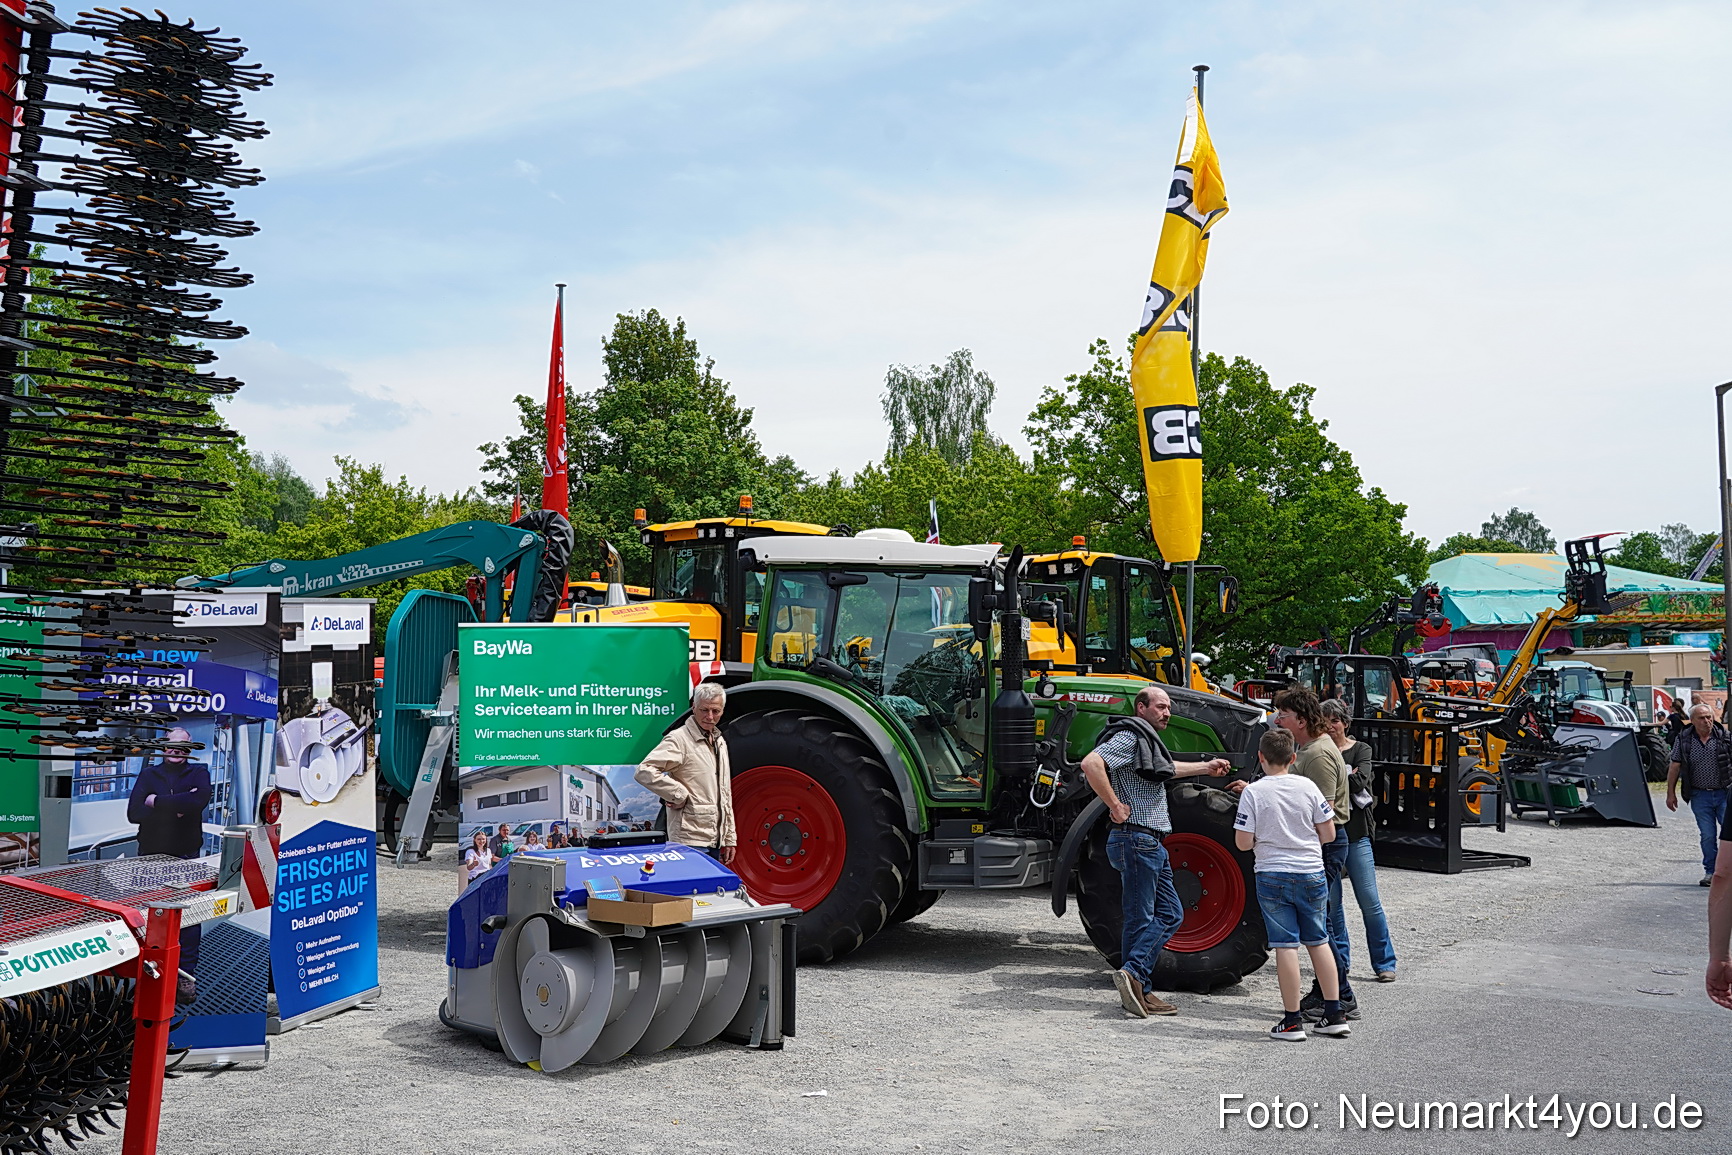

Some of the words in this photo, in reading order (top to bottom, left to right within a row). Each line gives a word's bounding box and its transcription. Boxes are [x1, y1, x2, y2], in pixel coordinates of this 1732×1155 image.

[676, 549, 693, 558] JCB
[341, 563, 369, 581] 4272
[201, 603, 257, 616] DeLaval
[323, 617, 364, 631] DeLaval
[105, 649, 146, 661] he
[153, 649, 200, 663] new
[474, 640, 533, 658] BayWa
[255, 690, 279, 706] DeLaval
[475, 685, 497, 698] Ihr
[500, 684, 544, 698] Melk-
[548, 684, 577, 697] und
[580, 683, 669, 699] Fütterungs-
[1068, 692, 1113, 703] FENDT
[166, 693, 226, 713] V300
[474, 702, 573, 717] Serviceteam
[575, 702, 588, 715] in
[592, 703, 628, 716] Ihrer
[631, 703, 675, 716] Nähe!
[1435, 710, 1454, 719] JCB
[474, 728, 495, 739] Wir
[497, 728, 543, 739] machen
[544, 730, 565, 739] uns
[566, 728, 594, 738] stark
[595, 728, 612, 738] für
[613, 728, 633, 738] Sie.
[278, 848, 307, 859] Schieben
[306, 845, 316, 854] Sie
[317, 844, 326, 852] Ihr
[327, 841, 342, 850] Futter
[343, 837, 356, 847] nicht
[357, 836, 367, 844] nur
[600, 849, 686, 866] DeLaval
[278, 848, 367, 886] FRISCHEN
[277, 887, 307, 913] SIE
[311, 881, 333, 905] ES
[336, 872, 369, 899] AUF
[291, 912, 326, 931] DeLaval
[305, 940, 318, 949] Mehr
[318, 934, 341, 946] Aufnahme
[8, 936, 112, 978] PÖTTINGER
[306, 951, 325, 962] Weniger
[307, 965, 326, 975] Weniger
[326, 961, 336, 970] Zeit
[308, 978, 323, 989] MEHR
[323, 973, 340, 984] MILCH
